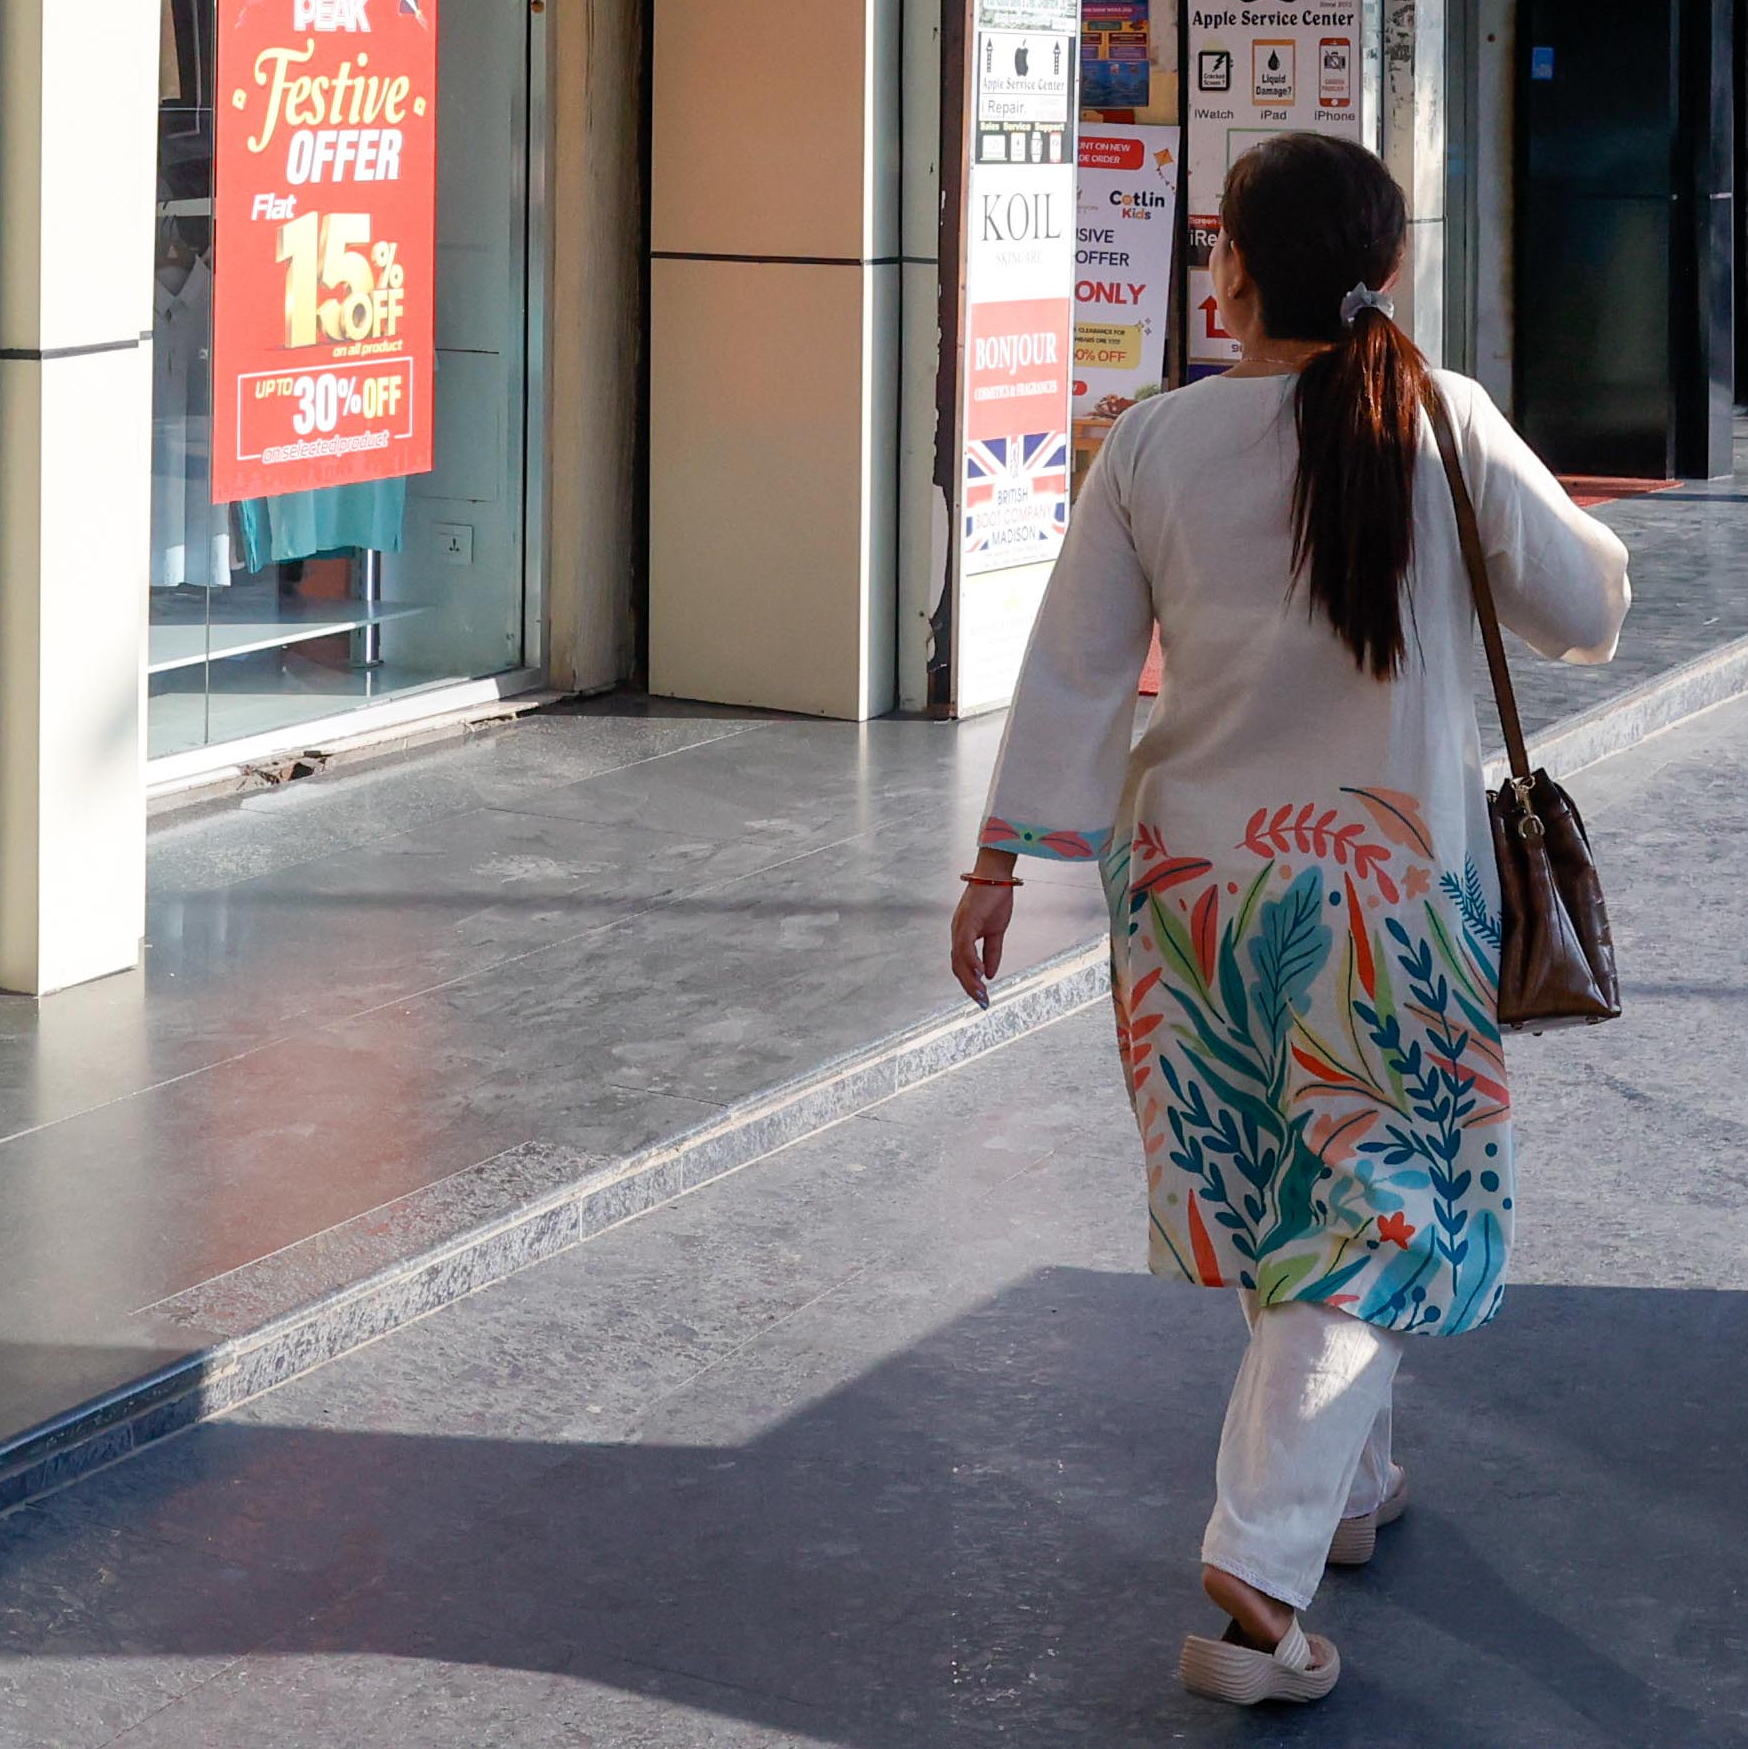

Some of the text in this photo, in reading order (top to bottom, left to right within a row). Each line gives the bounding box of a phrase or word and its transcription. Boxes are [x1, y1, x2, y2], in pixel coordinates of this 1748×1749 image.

[1192, 9, 1354, 29] Apple Service Center
[983, 77, 1065, 93] Apple Service Center
[1261, 73, 1286, 85] Liquid
[247, 38, 410, 153] Festive
[1255, 86, 1292, 98] Damage?
[1194, 109, 1234, 120] iWatch
[1260, 109, 1287, 120] iPad
[1314, 109, 1356, 121] iPhone
[286, 129, 403, 186] OFFER
[1091, 155, 1121, 164] ORDER
[250, 192, 297, 221] Flat
[1121, 207, 1152, 220] Kids
[980, 192, 1061, 243] KOIL
[1075, 250, 1130, 267] OFFER
[1075, 280, 1147, 306] ONLY
[343, 287, 404, 341] OFF
[332, 339, 404, 358] on all product
[974, 333, 1058, 375] BONJOUR
[1075, 348, 1128, 363] 0% OFF
[255, 373, 402, 435] UP TO 30% OFF
[261, 429, 389, 464] on selected product
[996, 488, 1028, 506] BRITISH
[975, 502, 1053, 530] BOOT COMPANY
[991, 525, 1037, 546] MADISON
